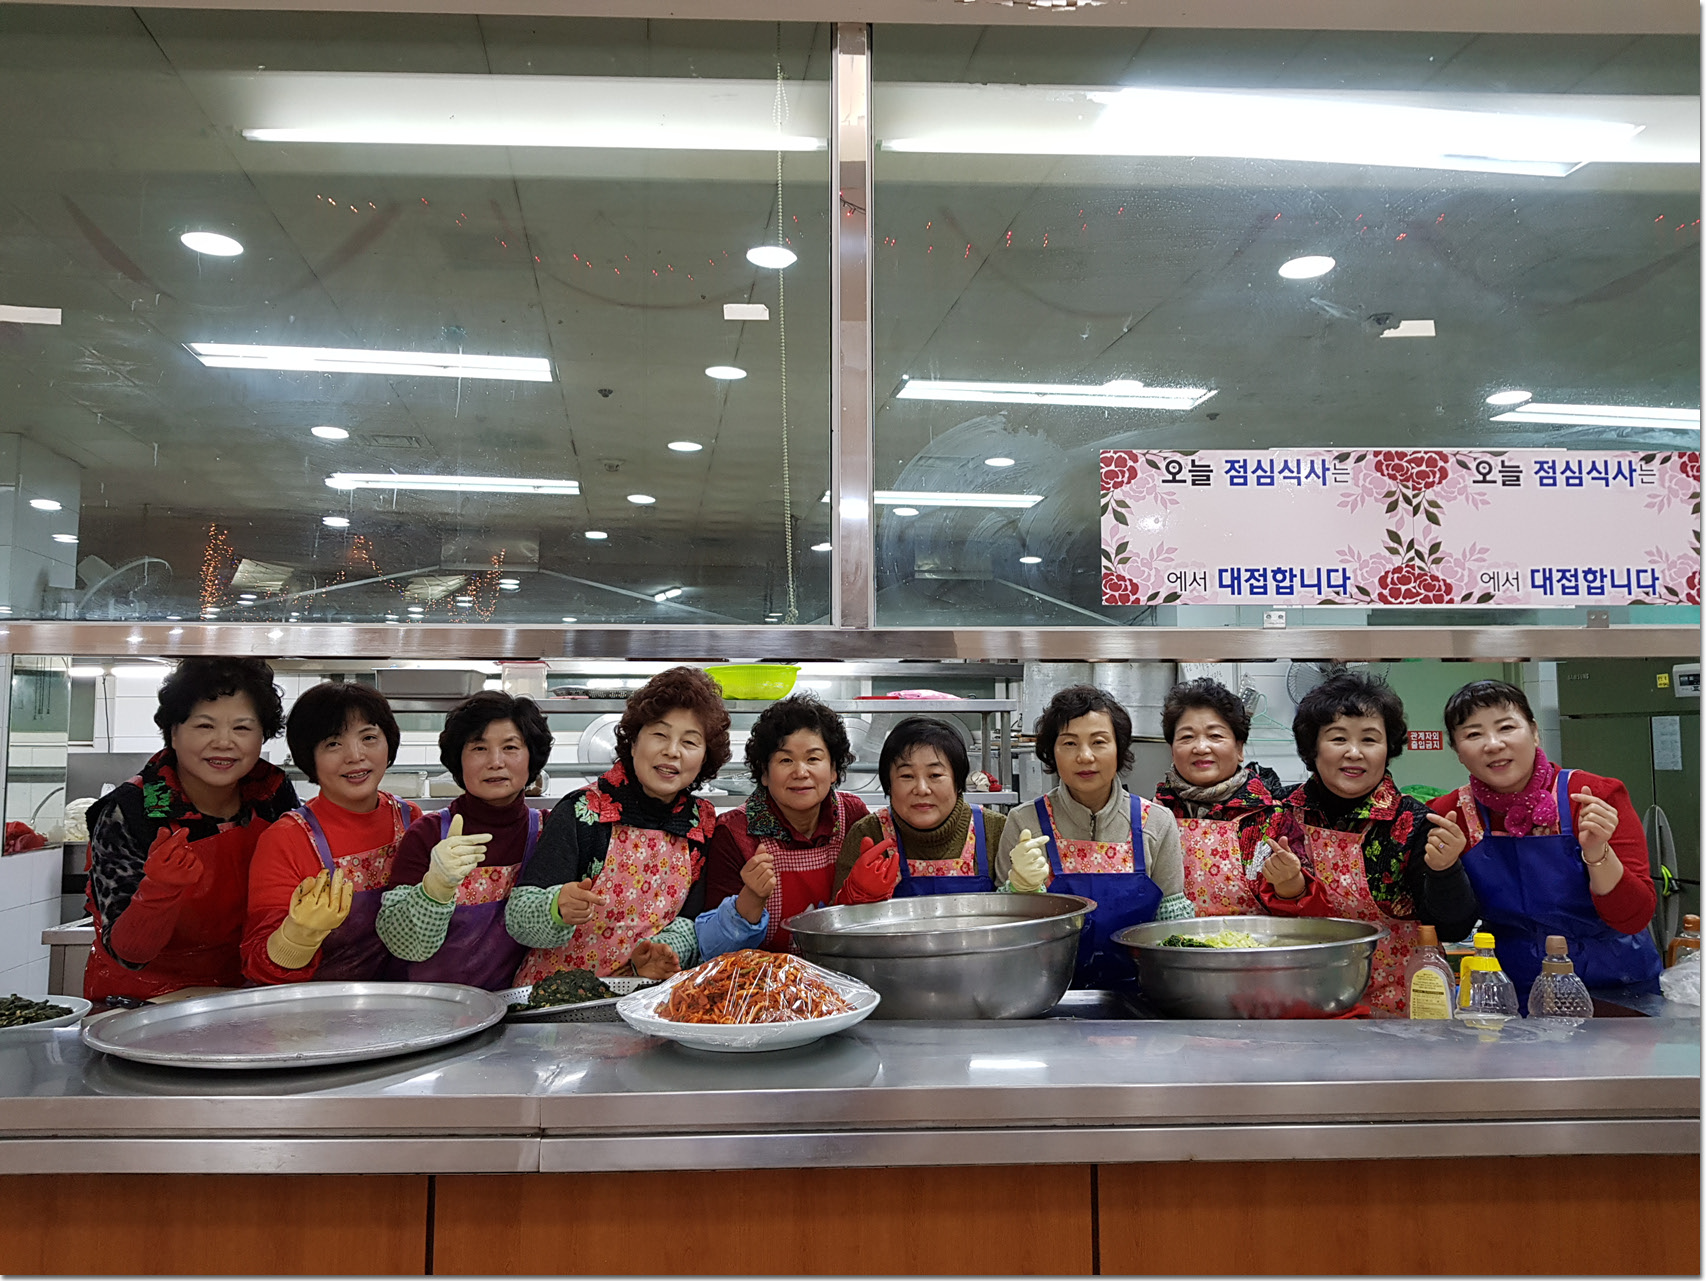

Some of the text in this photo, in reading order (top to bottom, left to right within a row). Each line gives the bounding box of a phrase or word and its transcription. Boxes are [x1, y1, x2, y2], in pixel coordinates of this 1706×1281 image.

[1161, 458, 1351, 487] 오늘 점심식사는
[1472, 459, 1657, 488] 오늘 점심식사는
[1166, 566, 1351, 596] 에서 대접합니다
[1479, 567, 1660, 596] 에서 대접합니다
[1410, 731, 1440, 741] 관계자외
[1411, 740, 1440, 750] 출입금지
